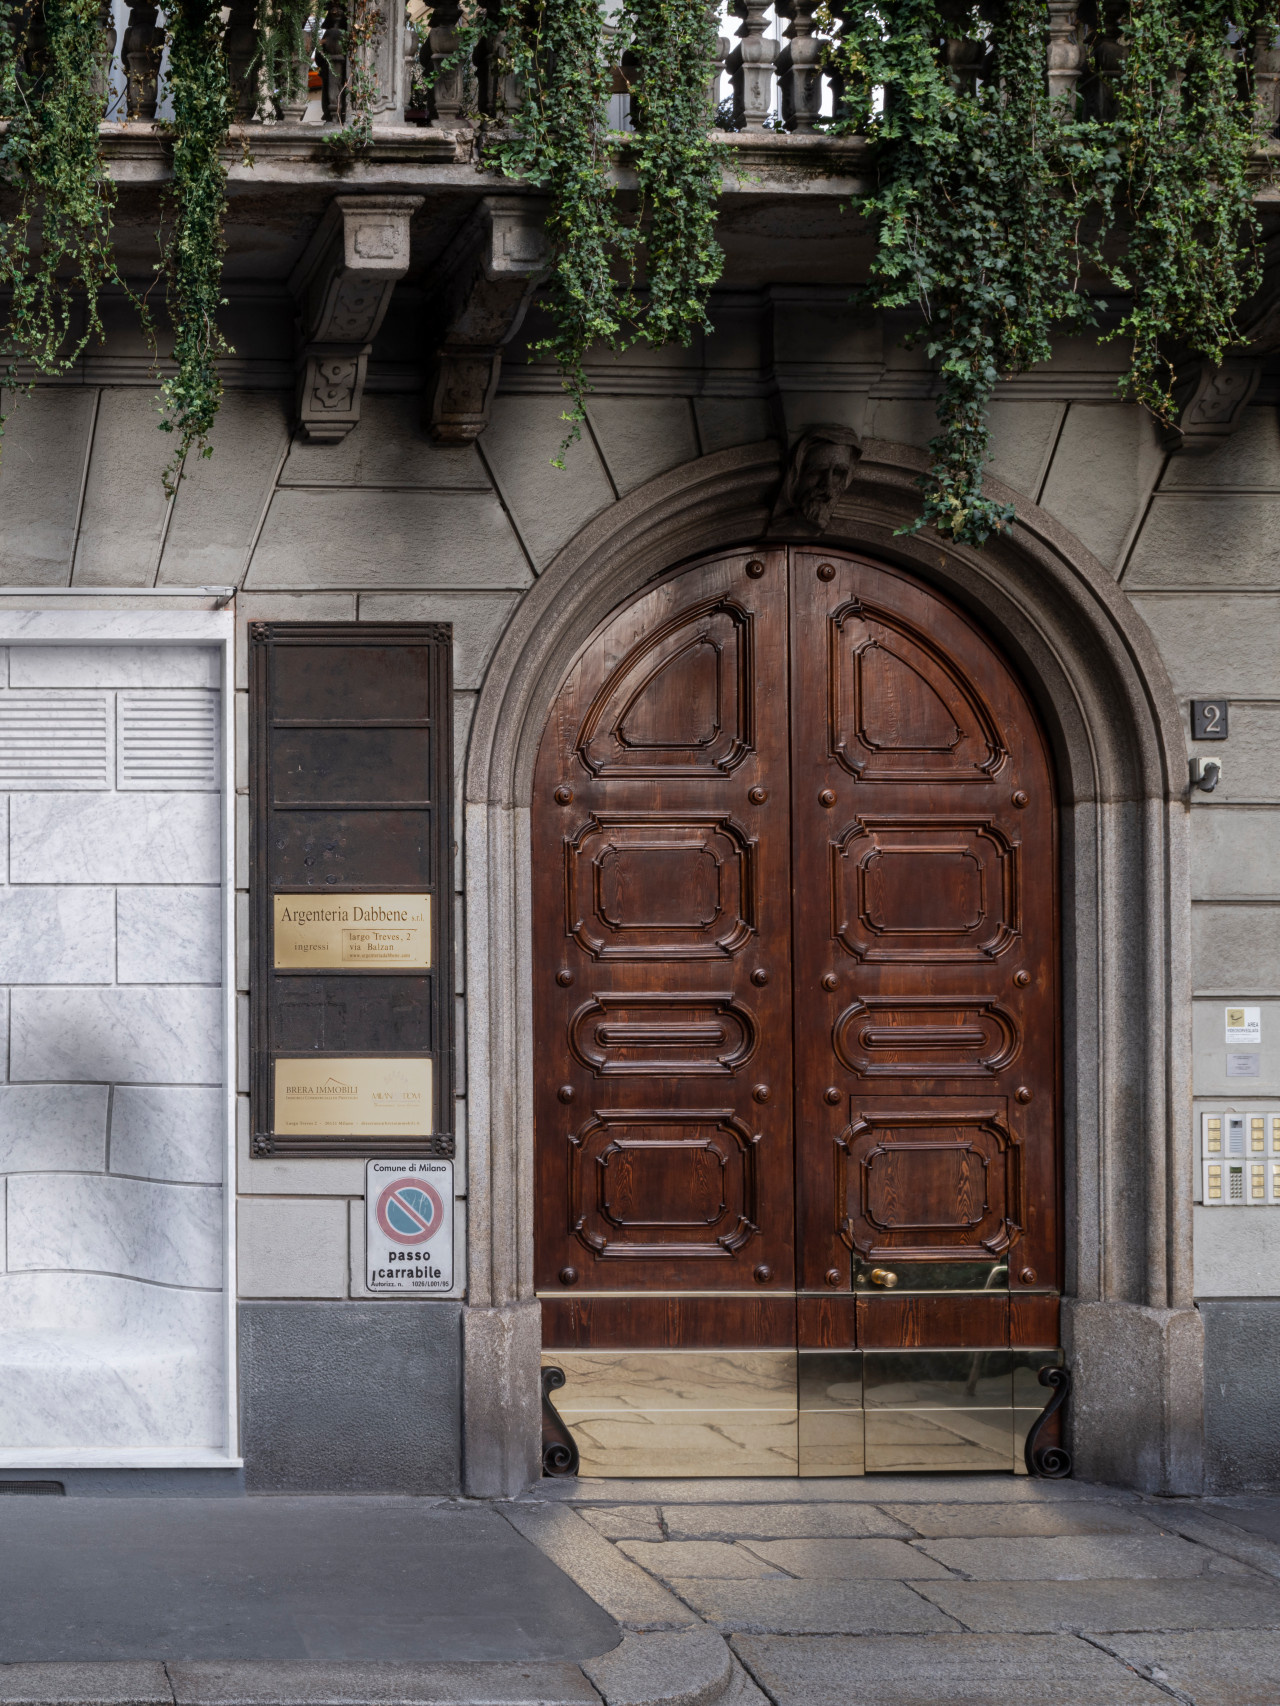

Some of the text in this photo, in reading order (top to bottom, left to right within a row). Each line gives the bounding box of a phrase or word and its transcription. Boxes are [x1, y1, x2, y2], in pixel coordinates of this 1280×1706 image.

[1204, 705, 1221, 732] 2
[280, 906, 349, 925] Argenteria
[352, 906, 408, 922] Dabbene
[349, 932, 370, 942] largo
[405, 932, 411, 941] 2
[294, 942, 329, 952] ingressi
[349, 943, 394, 951] via Balzan
[285, 1086, 358, 1094] BRERA IMMOBILI
[373, 1163, 447, 1172] Comune di Milano
[388, 1251, 431, 1263] passo
[378, 1266, 442, 1279] carrabile
